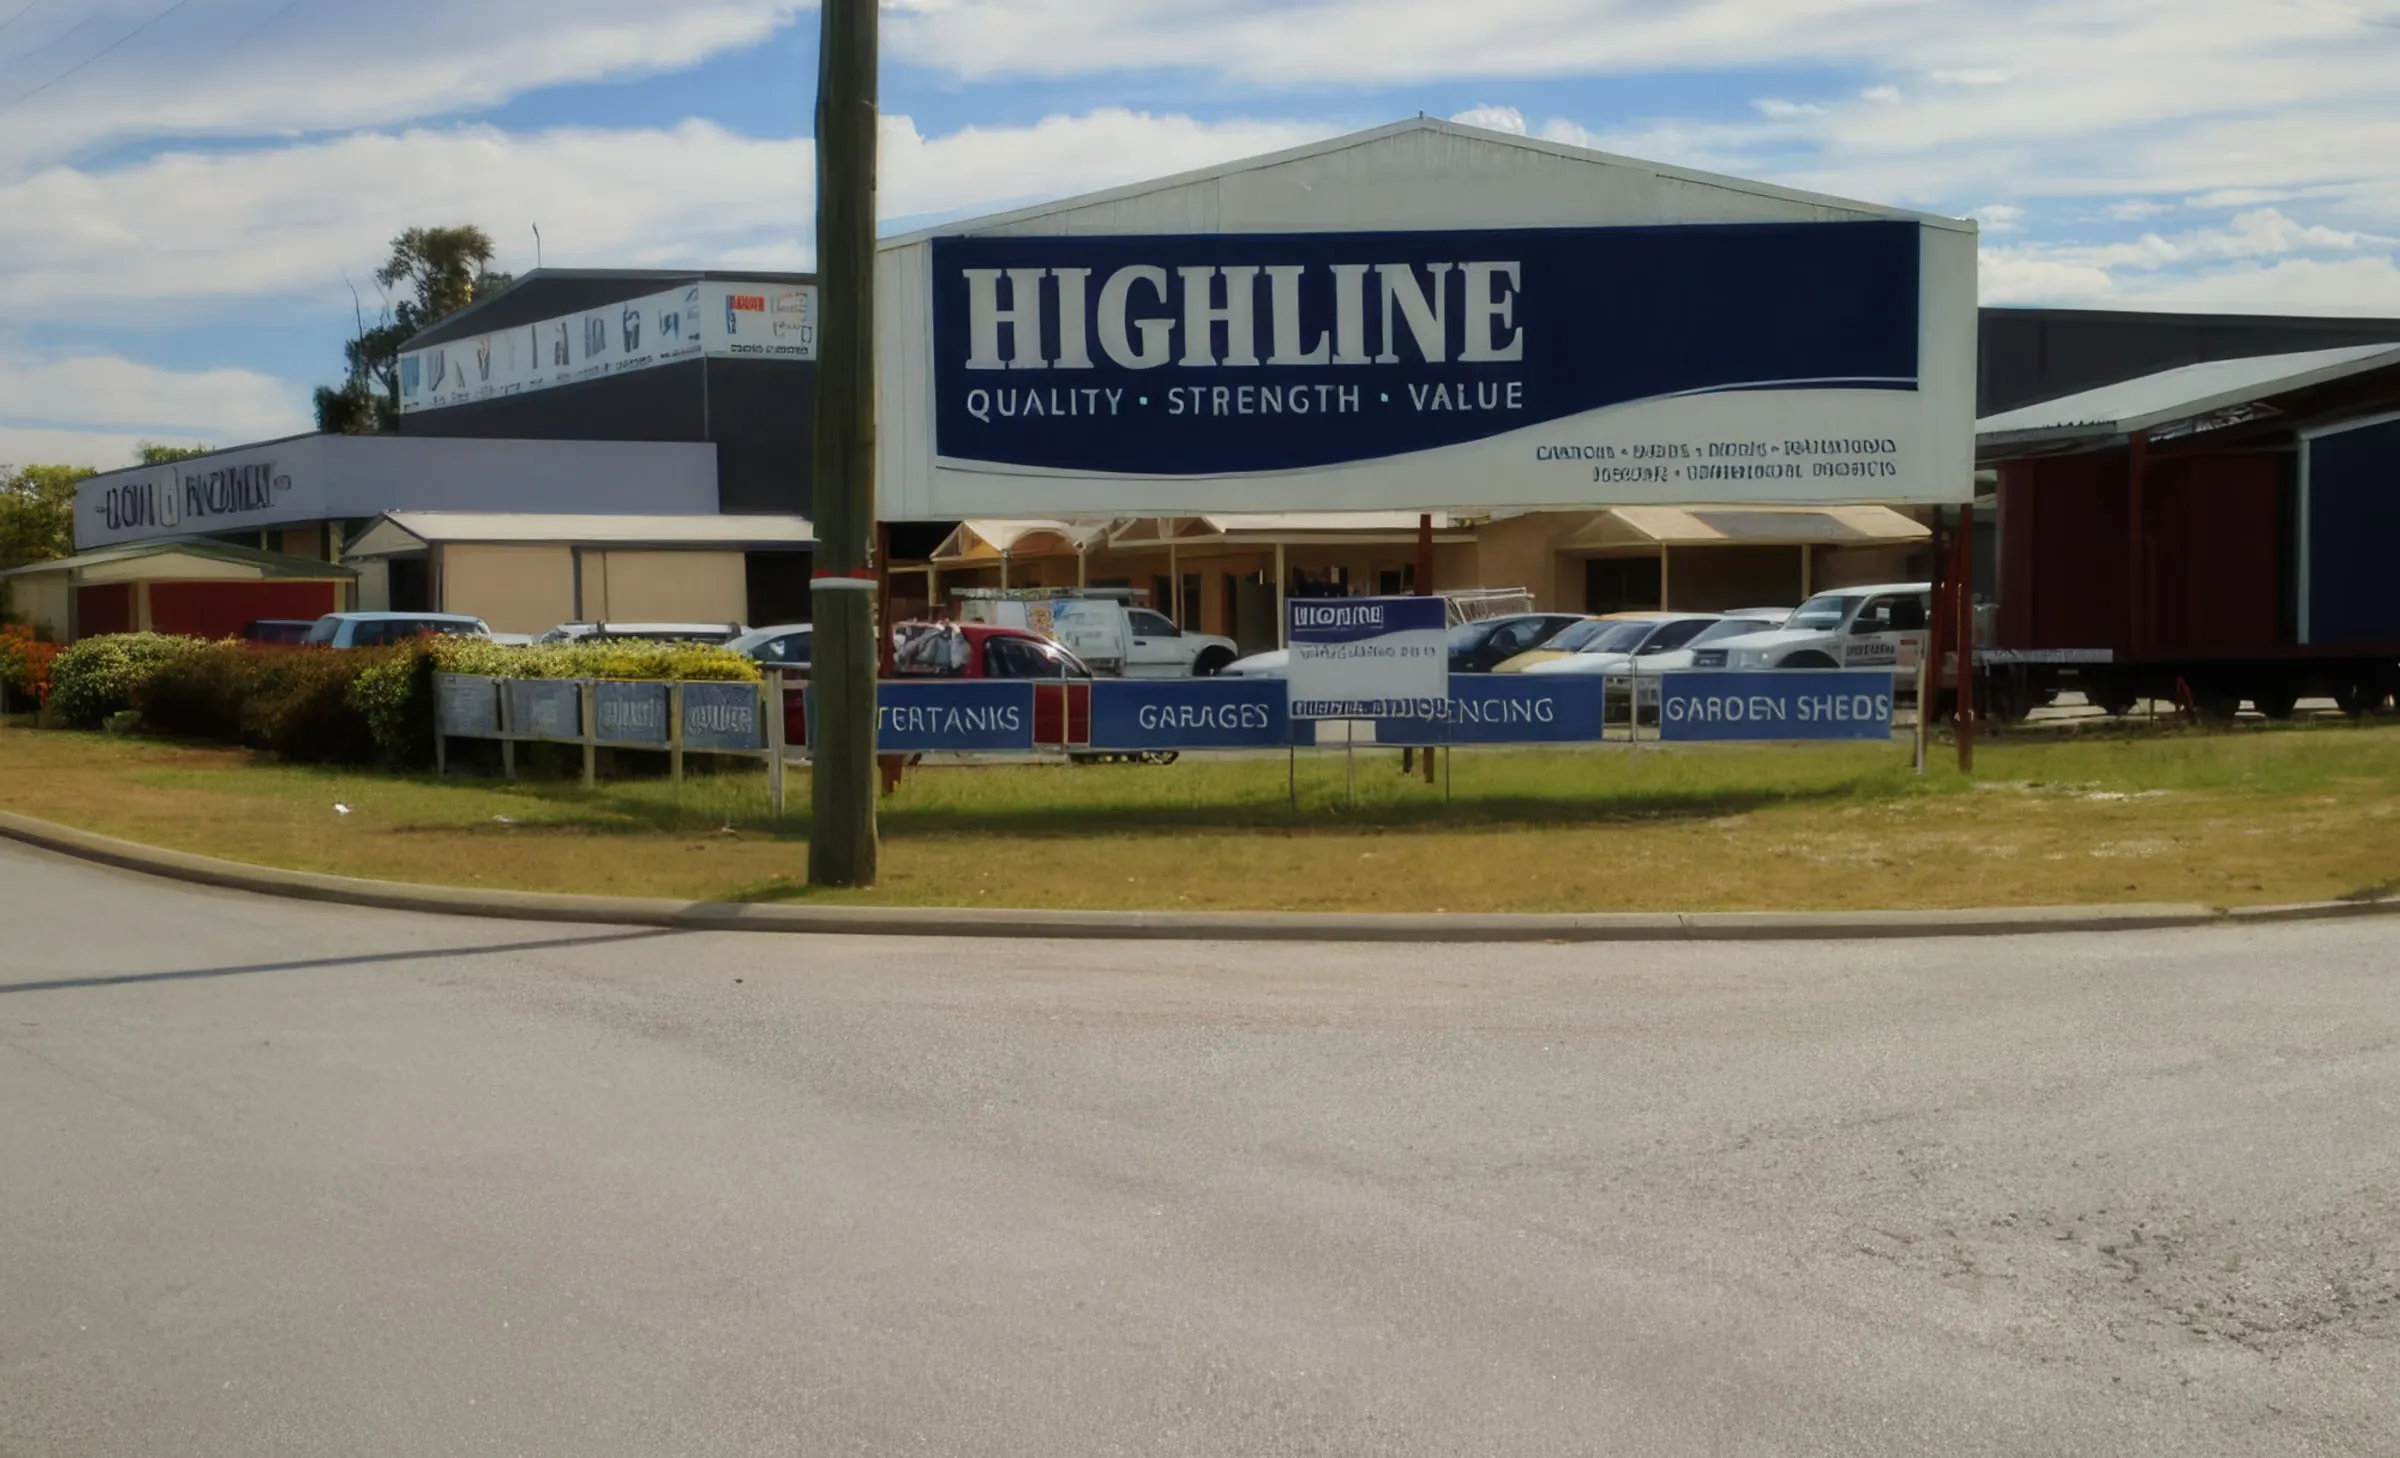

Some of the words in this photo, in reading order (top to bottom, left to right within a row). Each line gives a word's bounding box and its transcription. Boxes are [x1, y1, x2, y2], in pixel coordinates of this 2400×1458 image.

[962, 262, 1524, 370] HIGHLINE
[966, 388, 1123, 424] QUALITY
[1168, 384, 1360, 416] STRENGTH
[1407, 381, 1524, 412] VALUE
[878, 705, 1020, 734] TERTANKS
[1138, 703, 1270, 731] GARAGES
[1447, 697, 1554, 724] ENCING
[1666, 695, 1787, 722] GARDEN
[1797, 693, 1889, 722] SHEDS
